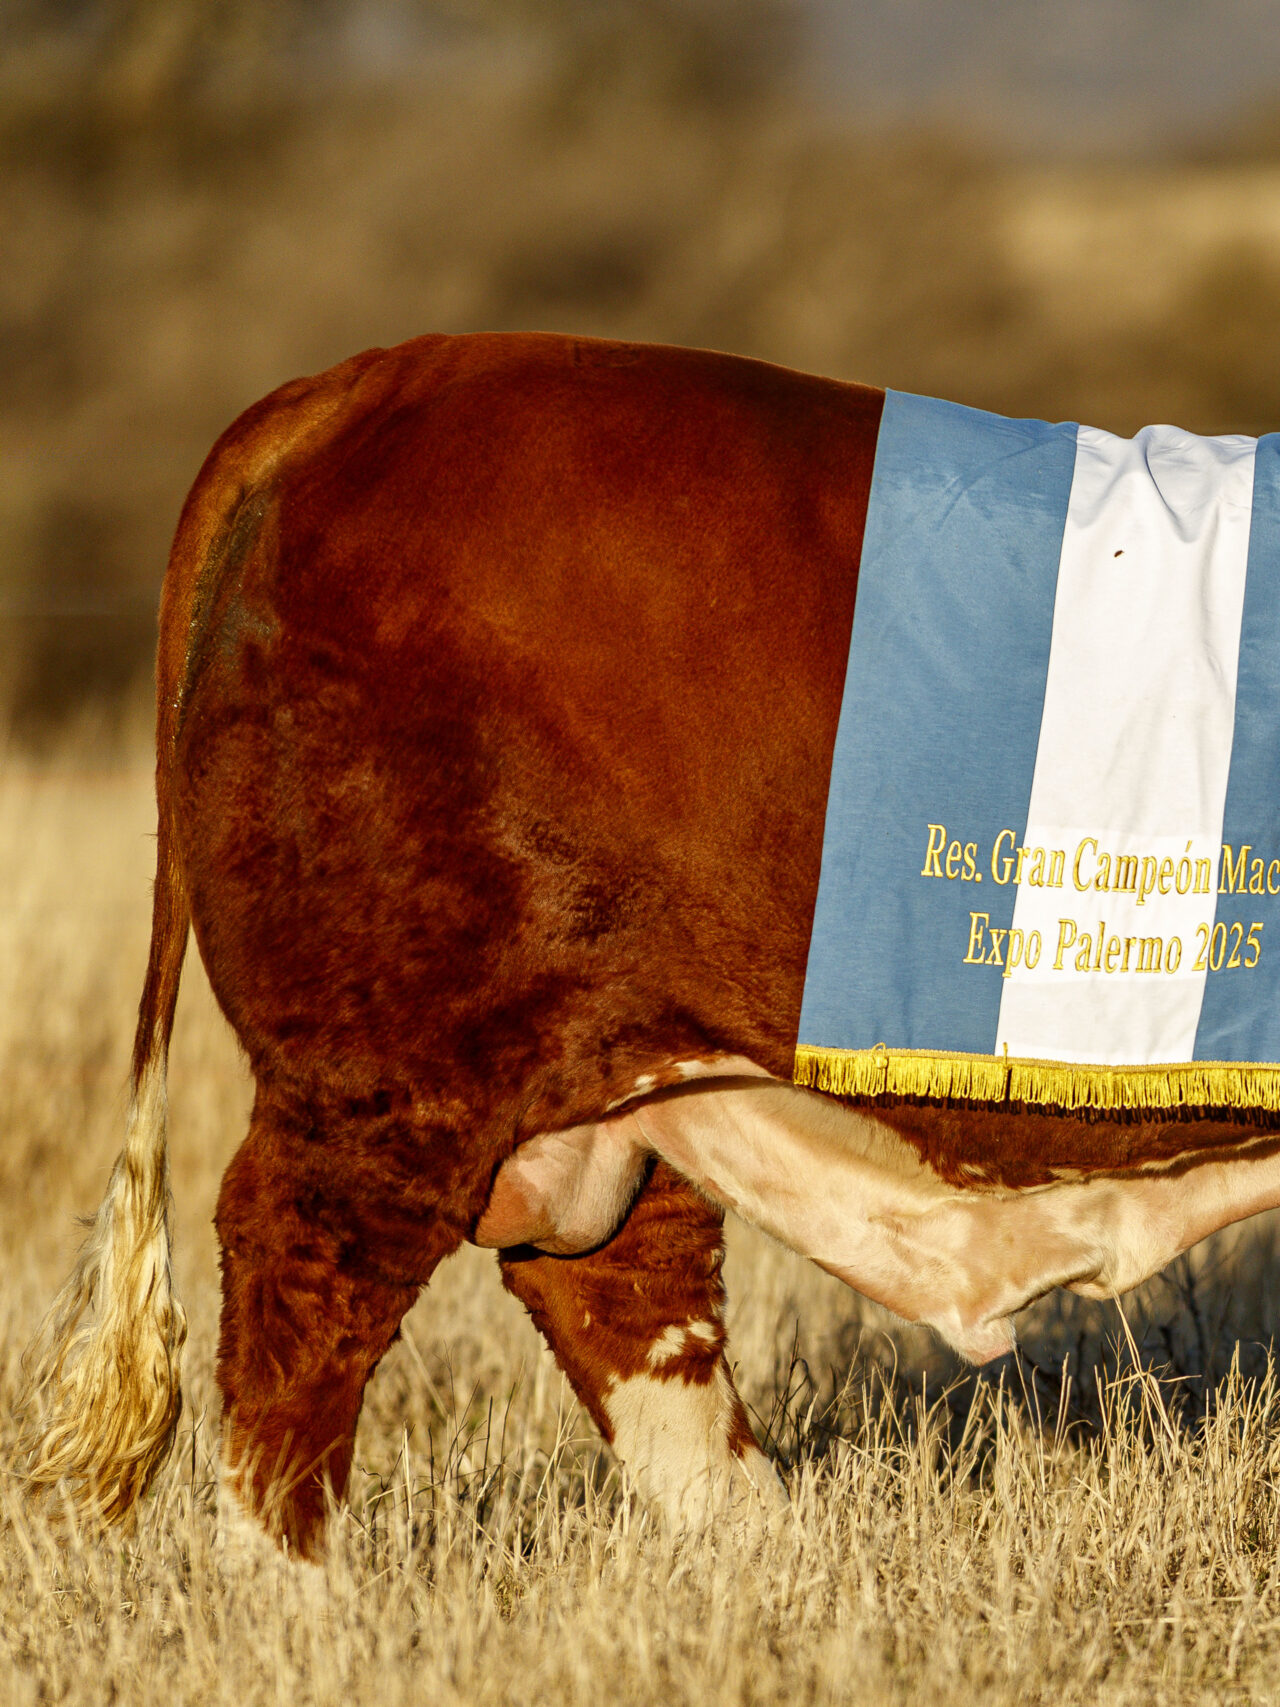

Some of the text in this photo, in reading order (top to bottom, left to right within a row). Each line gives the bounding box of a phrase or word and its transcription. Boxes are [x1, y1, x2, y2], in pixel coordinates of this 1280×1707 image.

[920, 824, 983, 883] Res.
[991, 829, 1065, 888] Gran
[1073, 838, 1211, 906] Campeón
[963, 911, 1264, 978] Expo Palermo 2025
